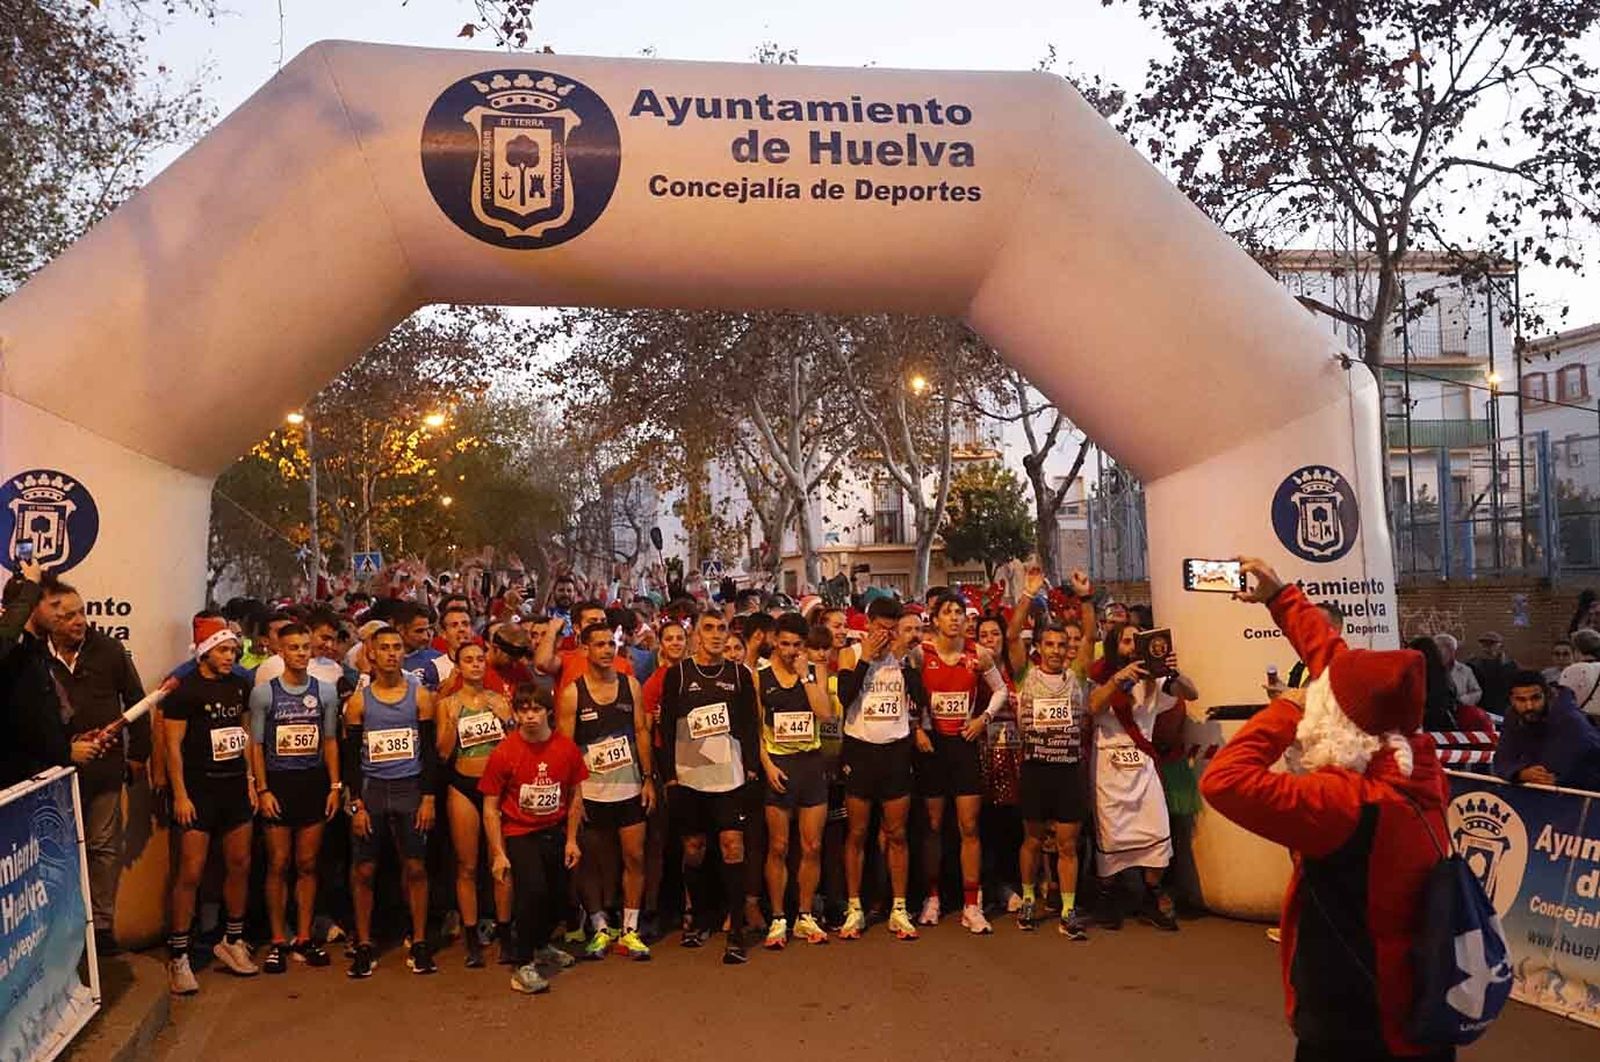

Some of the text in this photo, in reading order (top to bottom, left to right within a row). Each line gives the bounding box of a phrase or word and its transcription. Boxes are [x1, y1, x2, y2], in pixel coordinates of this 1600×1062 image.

[629, 88, 973, 126] Ayuntamiento
[501, 117, 545, 128] ET TERRA
[731, 130, 975, 167] de Huelva
[483, 161, 492, 199] PORTUS
[649, 174, 982, 206] Concejalía de Deportes
[878, 702, 898, 714] 478
[947, 700, 964, 712] 321
[1050, 707, 1069, 719] 286
[705, 712, 726, 726] 185
[475, 720, 497, 735] 324
[790, 720, 810, 733] 447
[294, 734, 315, 747] 567
[387, 738, 409, 751] 385
[607, 746, 626, 761] 191
[1121, 751, 1141, 762] 538
[537, 793, 557, 807] 228
[2, 878, 49, 935] Huelva
